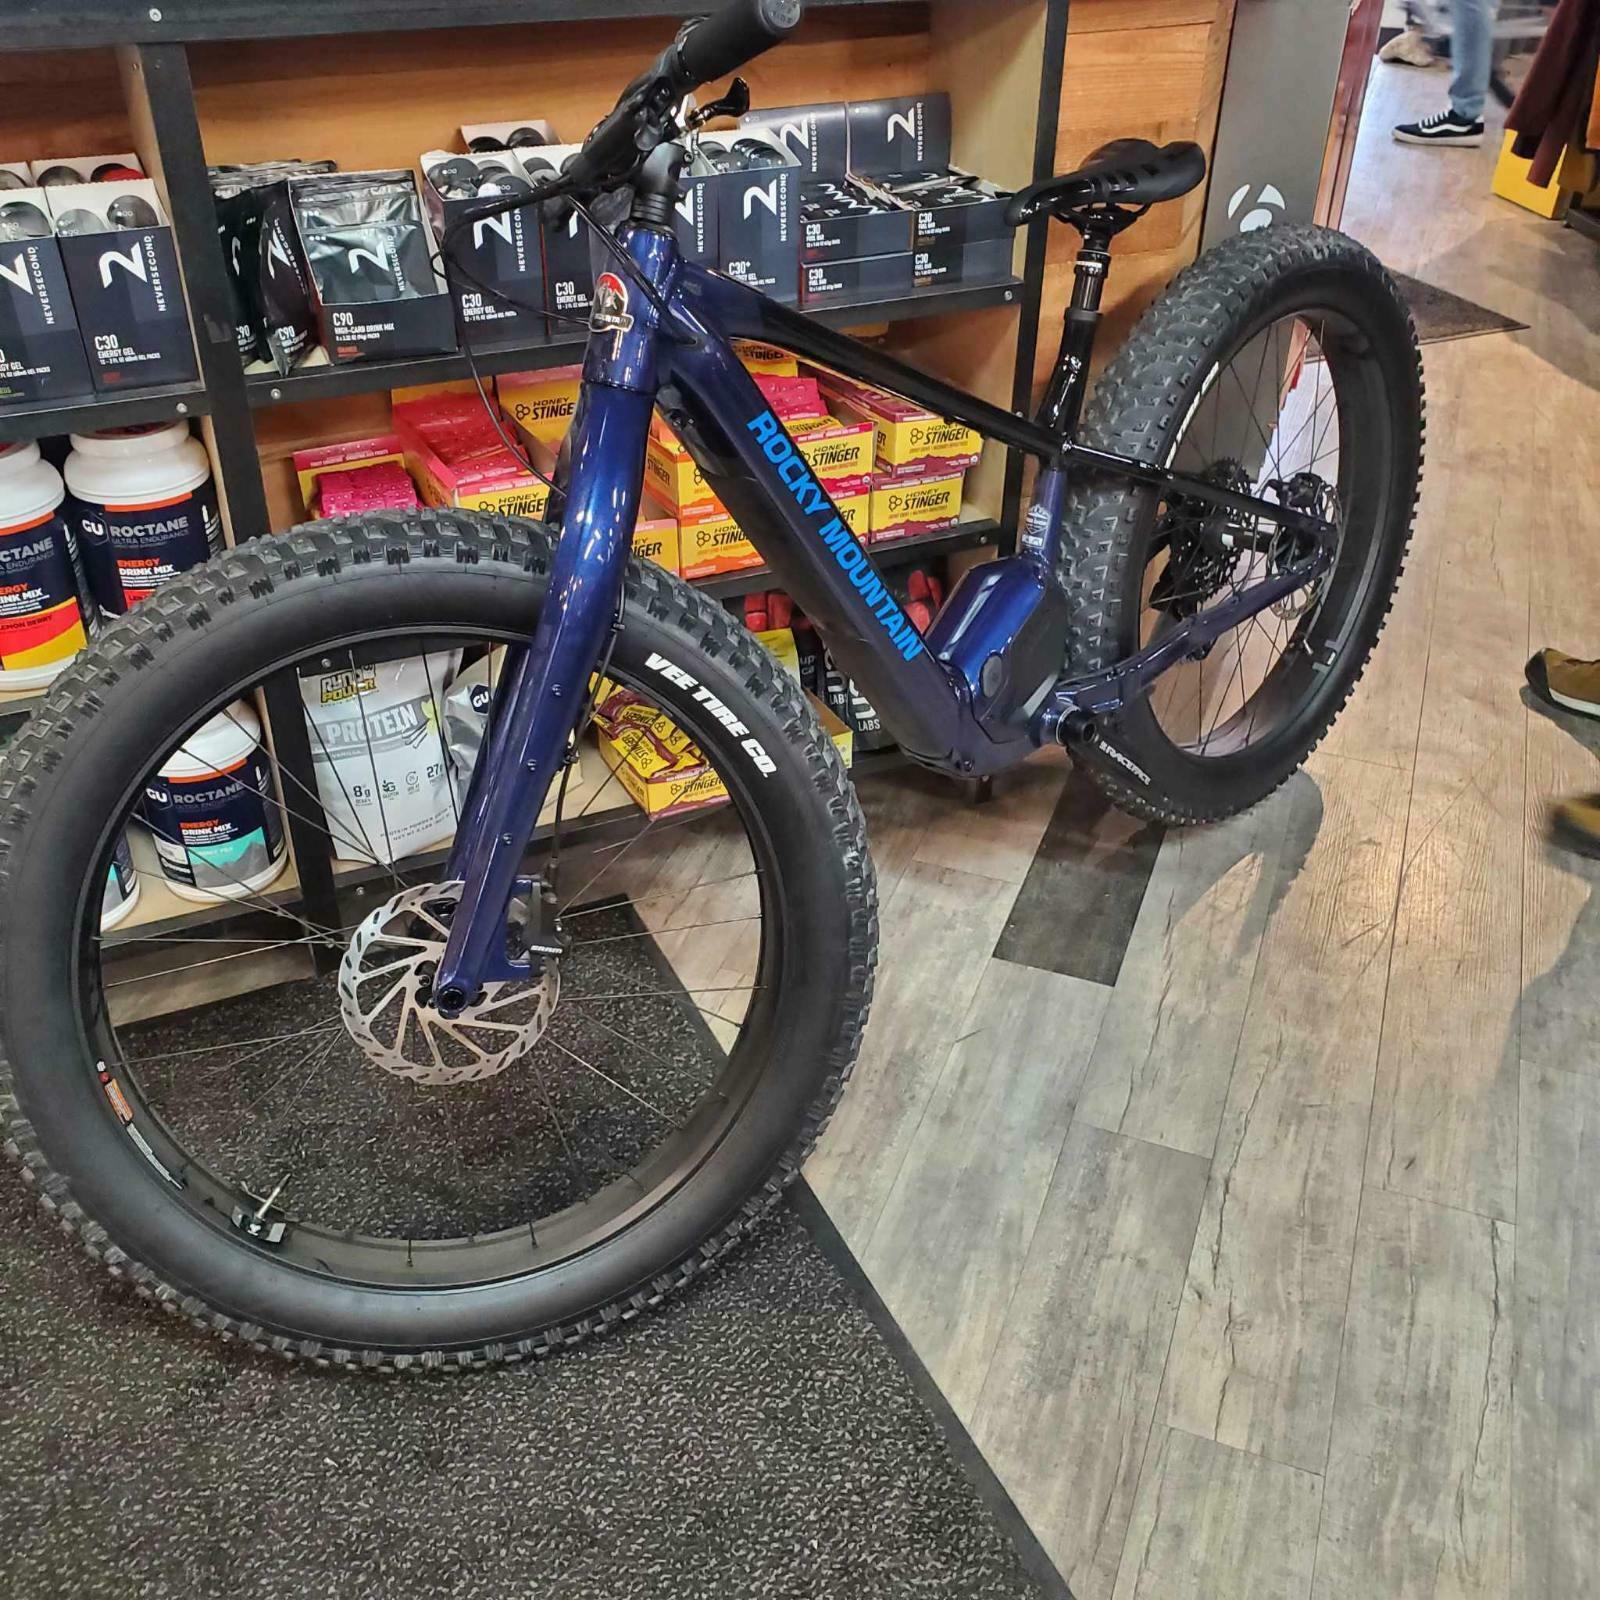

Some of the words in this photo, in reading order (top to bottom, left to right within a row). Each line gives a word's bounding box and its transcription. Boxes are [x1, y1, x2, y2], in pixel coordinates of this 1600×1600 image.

[780, 174, 788, 242] NEVERSECOND
[696, 183, 704, 252] NEVERSECOND
[918, 212, 932, 224] C30
[806, 223, 821, 235] C30
[915, 253, 929, 265] C30
[144, 235, 166, 312] NEVERSECOND
[809, 268, 823, 280] C30
[555, 281, 574, 296] C30
[462, 293, 481, 307] C30
[463, 307, 484, 316] ENERGY
[332, 312, 353, 326] C90
[95, 334, 119, 350] C30
[97, 349, 121, 359] ENERGY
[533, 397, 570, 407] HONEY
[532, 402, 576, 420] STINGE
[814, 442, 848, 452] HONEY
[812, 447, 860, 467] STINGER
[499, 493, 539, 503] HONEY
[906, 488, 938, 498] HONEY
[904, 491, 950, 511] STINGER
[82, 520, 104, 536] GU
[110, 516, 189, 537] ROCTANE
[747, 410, 830, 516] ROCKY
[818, 516, 925, 662] MOUNTAIN
[0, 536, 54, 562] CTANE
[117, 558, 160, 567] ENERGY
[119, 568, 152, 576] DRINK
[154, 564, 174, 574] MIX
[0, 582, 28, 595] ERGY
[22, 588, 43, 600] MIX
[472, 691, 489, 707] GU
[644, 652, 699, 690] VEE
[692, 686, 750, 737] TIRE
[326, 704, 419, 746] PROTEIN
[858, 719, 880, 731] LABS
[146, 788, 168, 802] GU
[182, 828, 212, 836] DRINK
[214, 823, 232, 833] MIX
